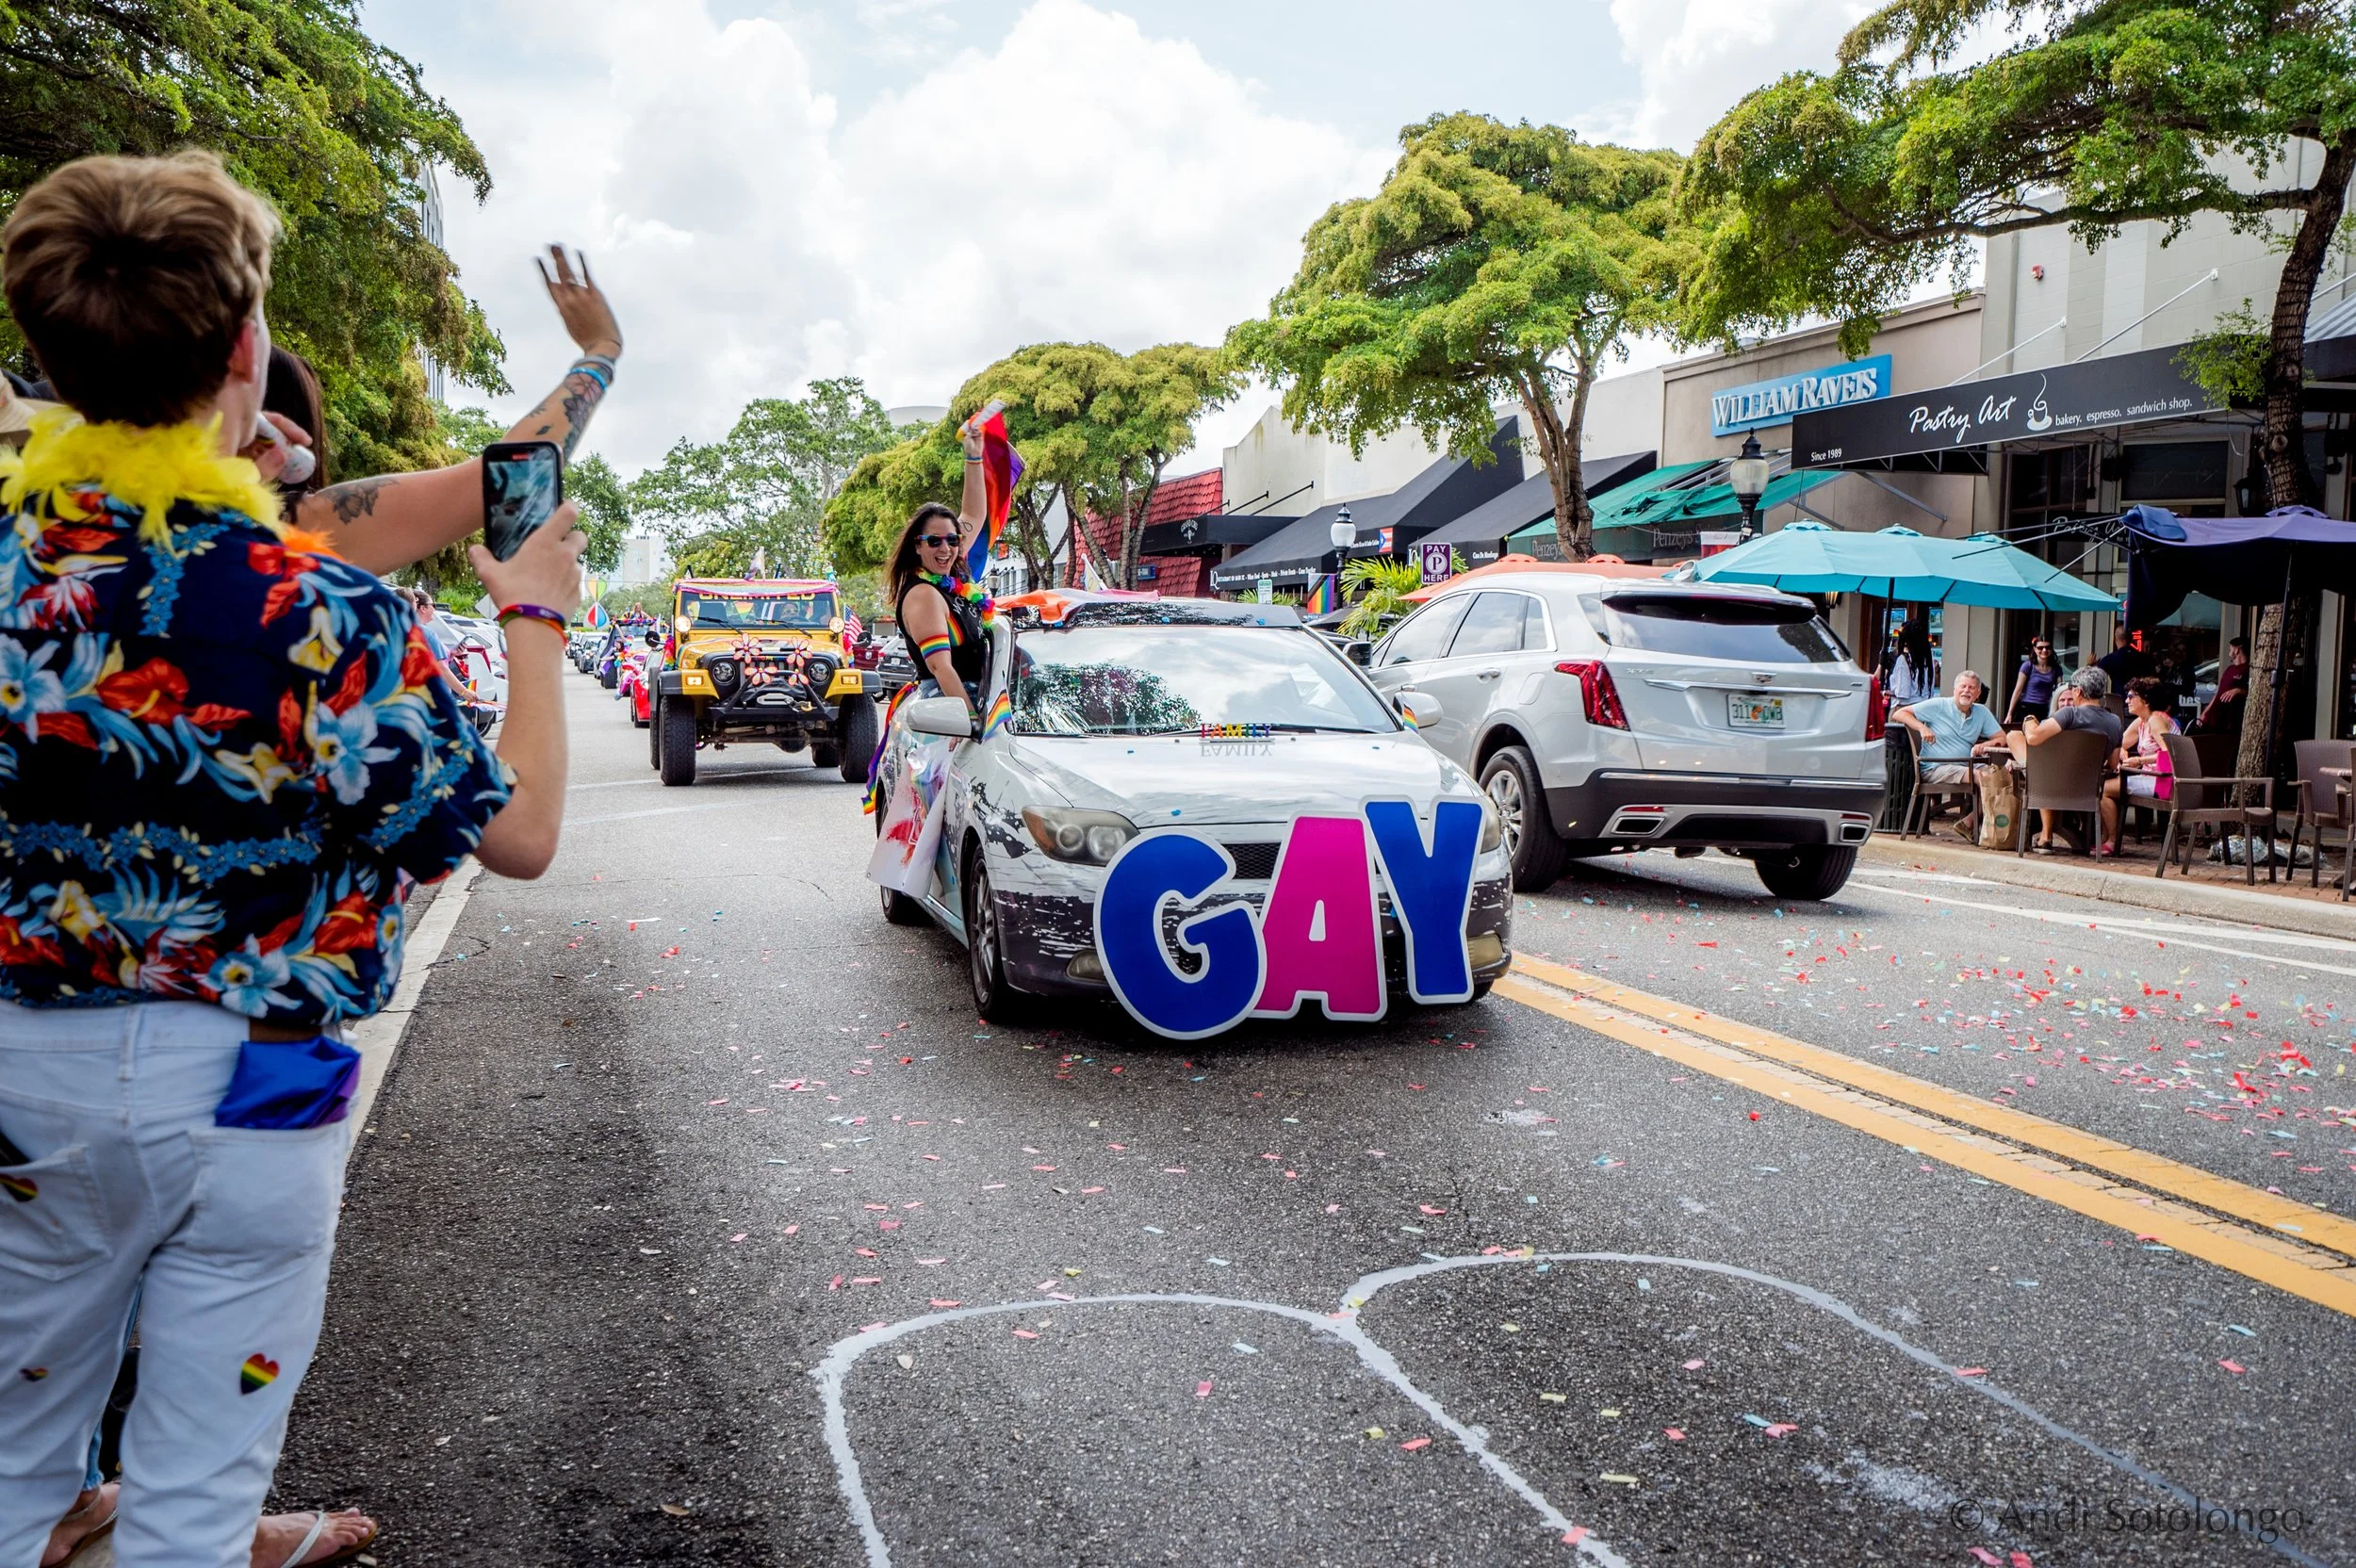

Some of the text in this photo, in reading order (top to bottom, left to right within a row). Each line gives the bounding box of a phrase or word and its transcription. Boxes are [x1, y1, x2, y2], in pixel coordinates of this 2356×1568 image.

[1711, 368, 1878, 428] WILLIAM RAVEIS
[1908, 395, 2017, 444] Pastry Art
[2055, 397, 2193, 427] bakery. espresso. sandwich shop.
[1810, 448, 1842, 462] Since 1989
[1426, 545, 1447, 553] PAY
[1432, 557, 1443, 571] P
[1423, 574, 1449, 582] HERE
[1201, 723, 1275, 739] FAMILY
[1092, 794, 1488, 1040] GAY
